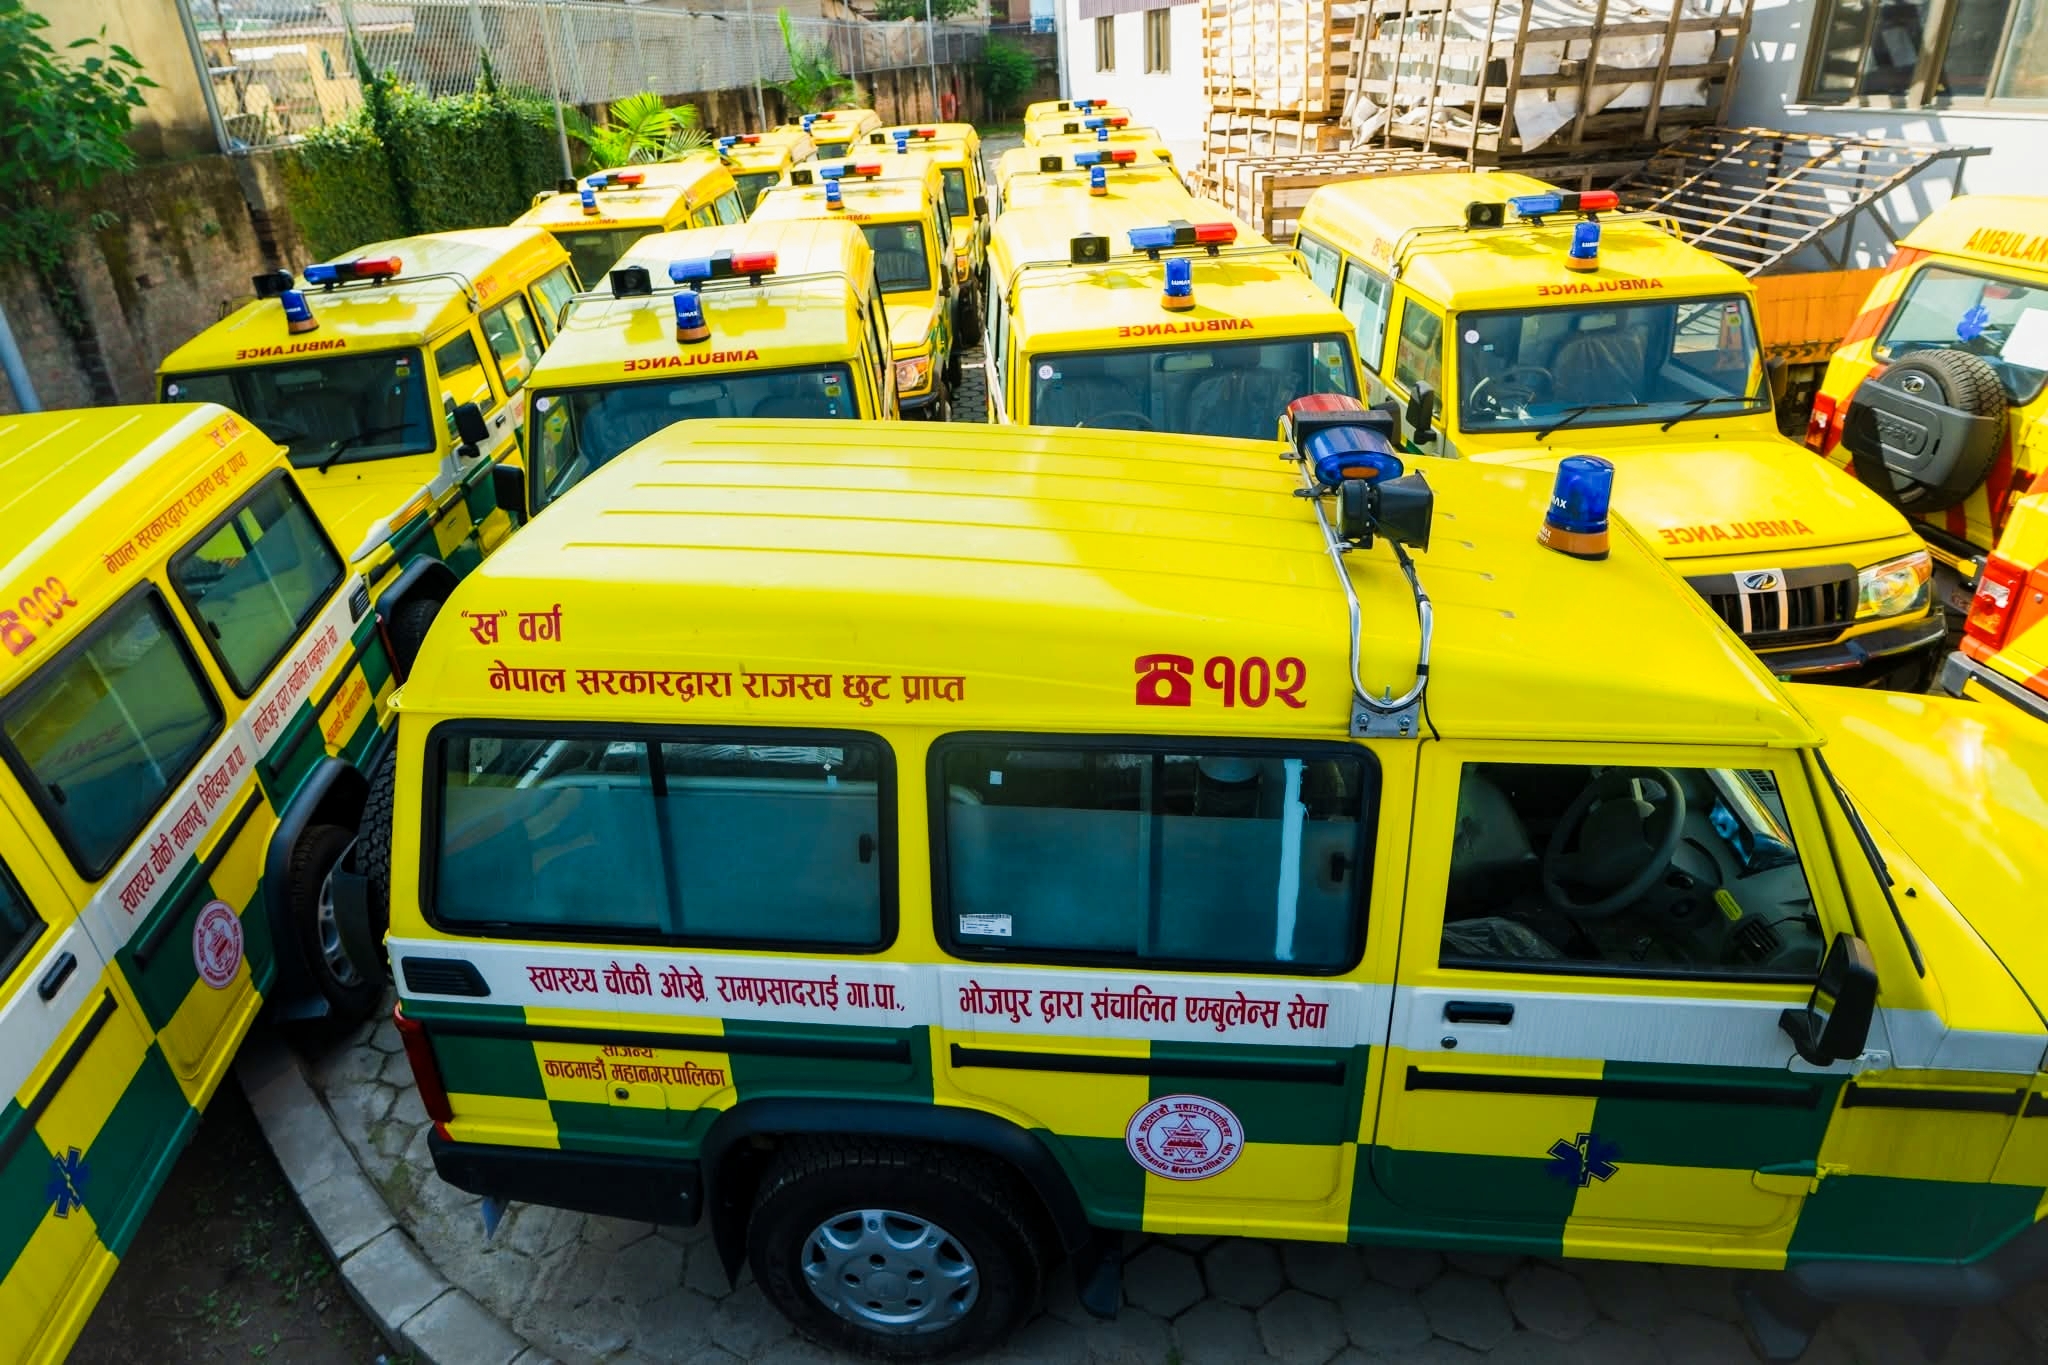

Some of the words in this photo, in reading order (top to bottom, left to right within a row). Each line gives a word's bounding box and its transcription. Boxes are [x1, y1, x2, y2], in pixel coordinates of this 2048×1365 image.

[18, 576, 78, 628] १०२
[518, 603, 563, 643] वर्ग
[488, 659, 566, 694] नेपाल
[575, 669, 732, 703] सरकारद्वारा
[741, 672, 833, 701] राजस्व
[842, 674, 891, 708] छुट
[901, 675, 966, 705] प्राप्त
[1203, 655, 1308, 709] १०२
[118, 862, 156, 915] स्वास्थ्य
[149, 832, 176, 875] चौकी
[525, 965, 599, 994] स्वास्थ्य
[602, 960, 652, 997] चौकी
[659, 965, 709, 1004] ओख्रे,
[714, 974, 839, 1011] रामप्रसादराई
[959, 979, 1033, 1023] भोजपुर
[1039, 990, 1084, 1023] द्वारा
[1090, 984, 1178, 1022] संचालित
[1184, 990, 1281, 1032] एम्बुलेन्स
[1287, 993, 1329, 1030] सेवा
[609, 1060, 726, 1088] महानगरपालिका
[1171, 1156, 1225, 1174] Metropolitan
